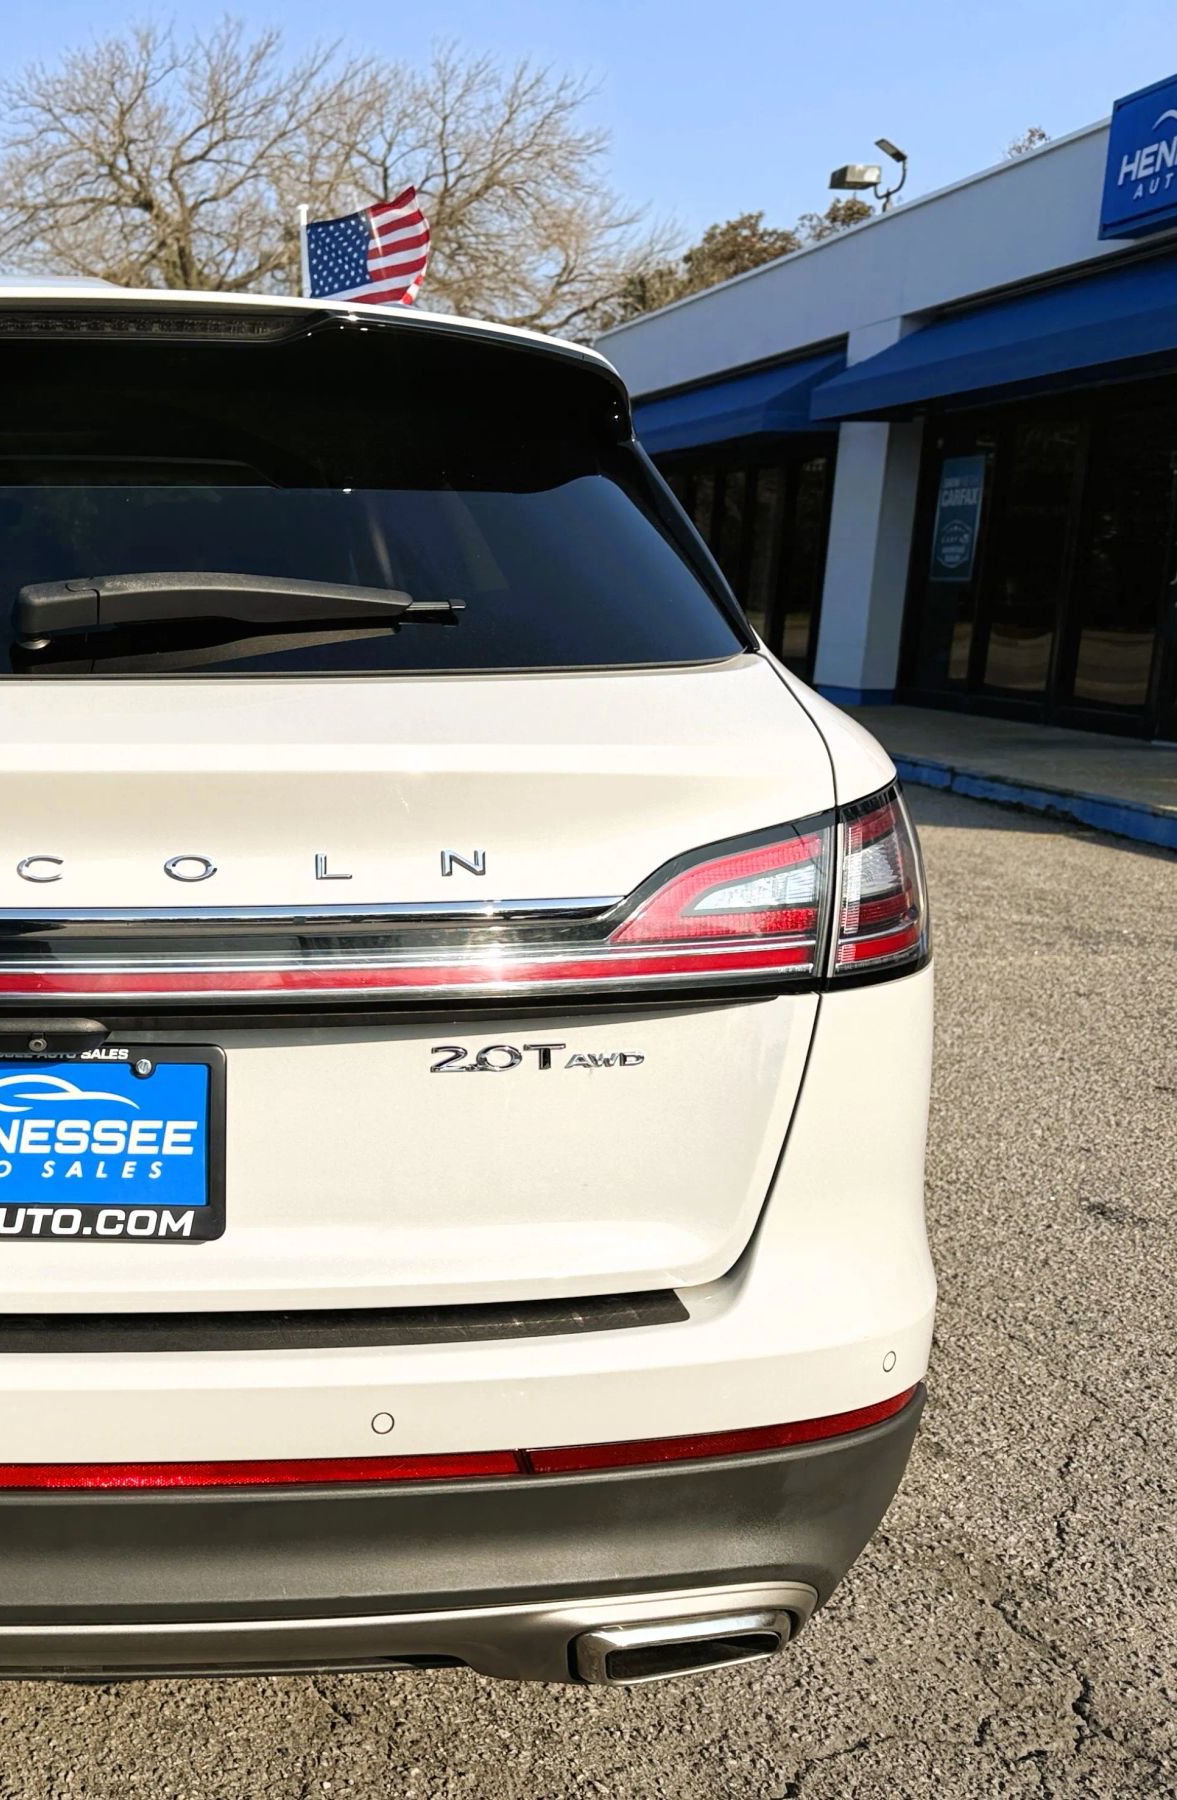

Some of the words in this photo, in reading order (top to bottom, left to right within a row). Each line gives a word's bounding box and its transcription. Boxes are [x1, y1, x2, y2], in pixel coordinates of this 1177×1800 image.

[1117, 135, 1177, 186] HEN
[80, 1048, 129, 1060] SALES
[564, 1052, 645, 1069] AWD
[41, 1160, 163, 1179] SALES
